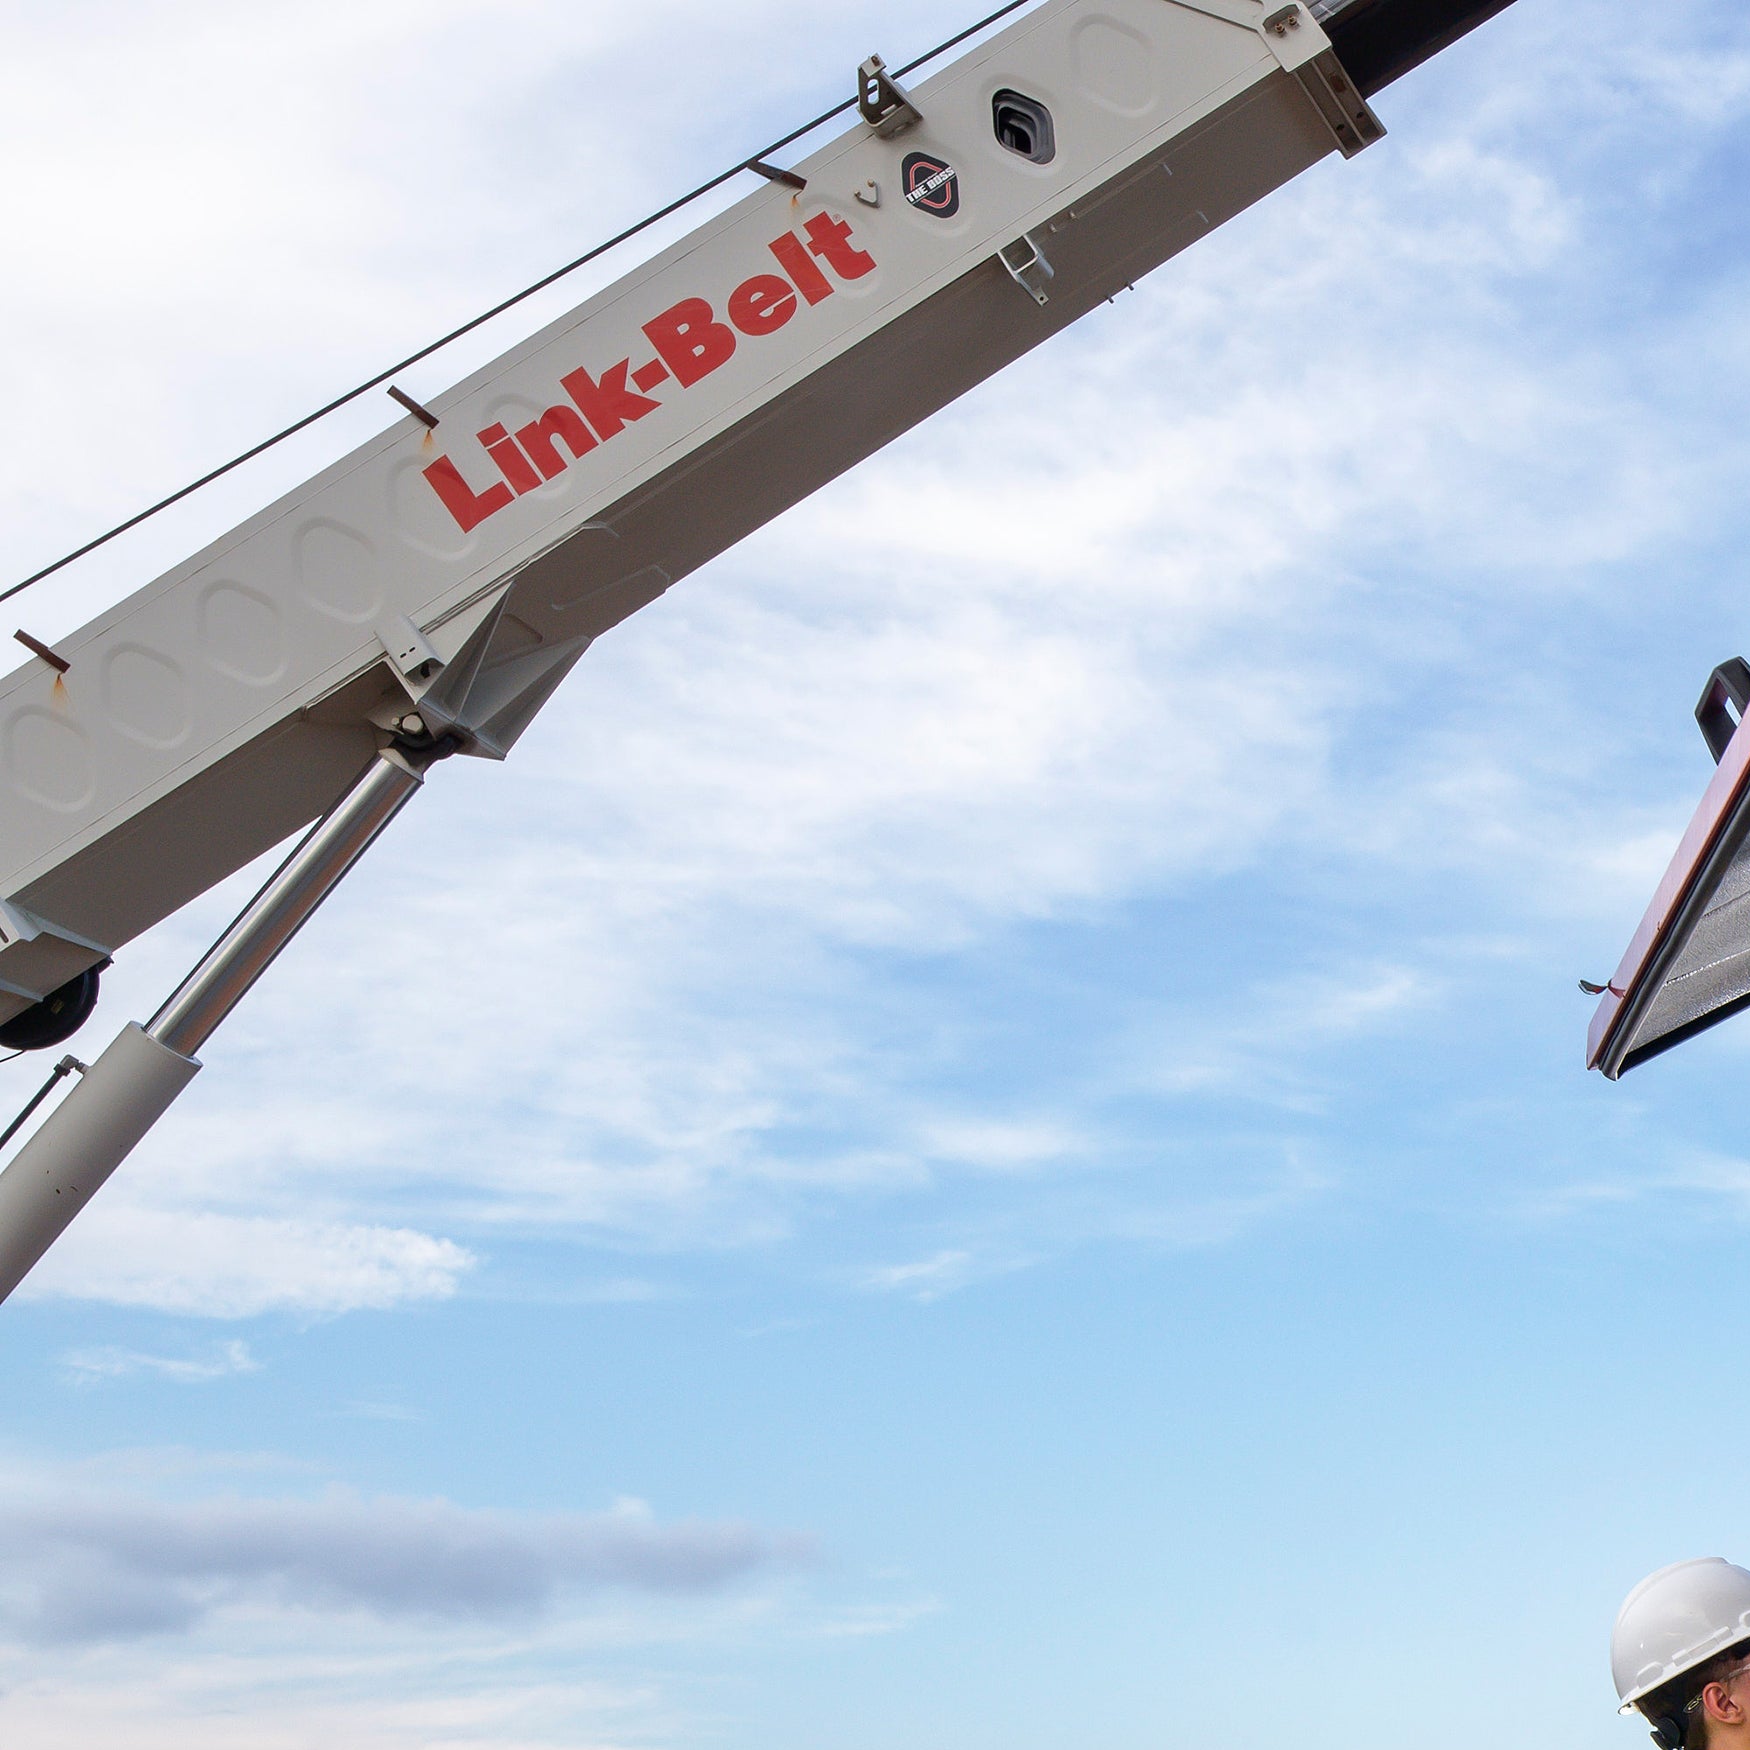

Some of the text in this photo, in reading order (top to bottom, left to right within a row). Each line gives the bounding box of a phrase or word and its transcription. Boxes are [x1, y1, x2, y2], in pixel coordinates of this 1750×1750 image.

[906, 166, 956, 202] THE BOSS
[423, 211, 877, 534] Link-Belt
